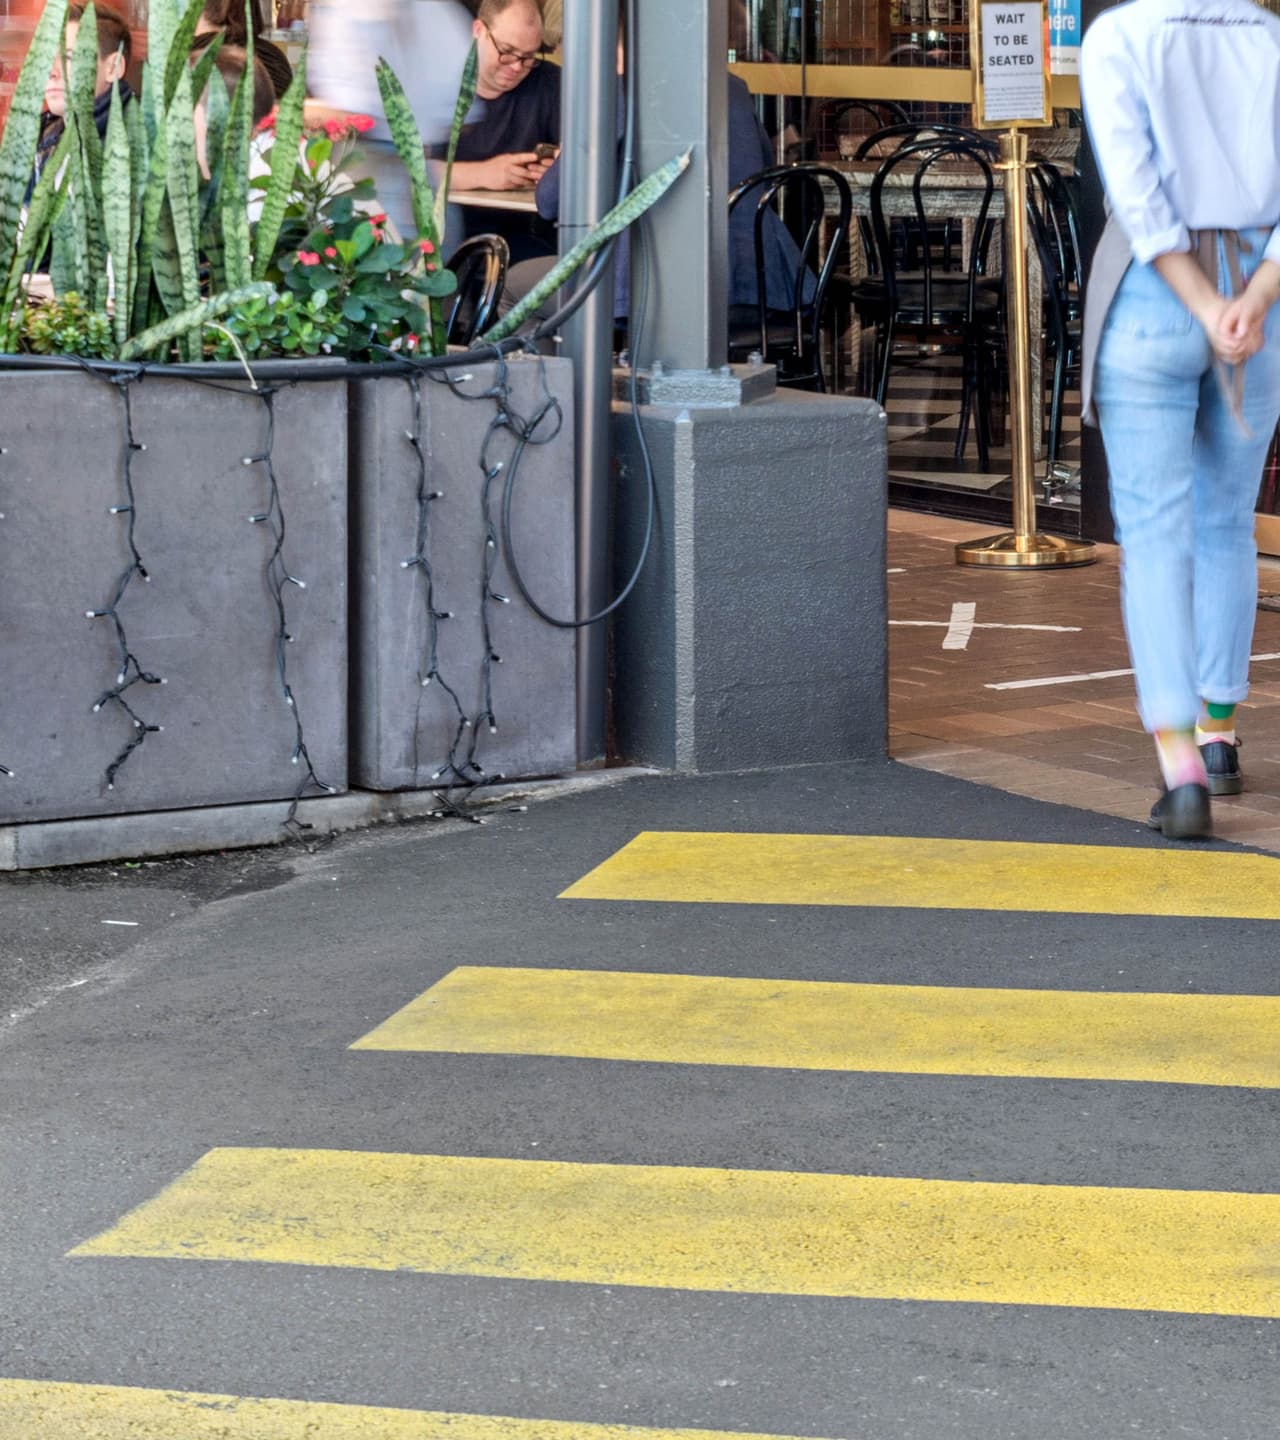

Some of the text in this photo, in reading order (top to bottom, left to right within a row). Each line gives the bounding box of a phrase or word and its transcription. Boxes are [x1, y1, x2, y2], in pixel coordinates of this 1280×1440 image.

[995, 13, 1026, 25] WAIT
[993, 34, 1029, 47] TO BE
[988, 54, 1035, 67] SEATED
